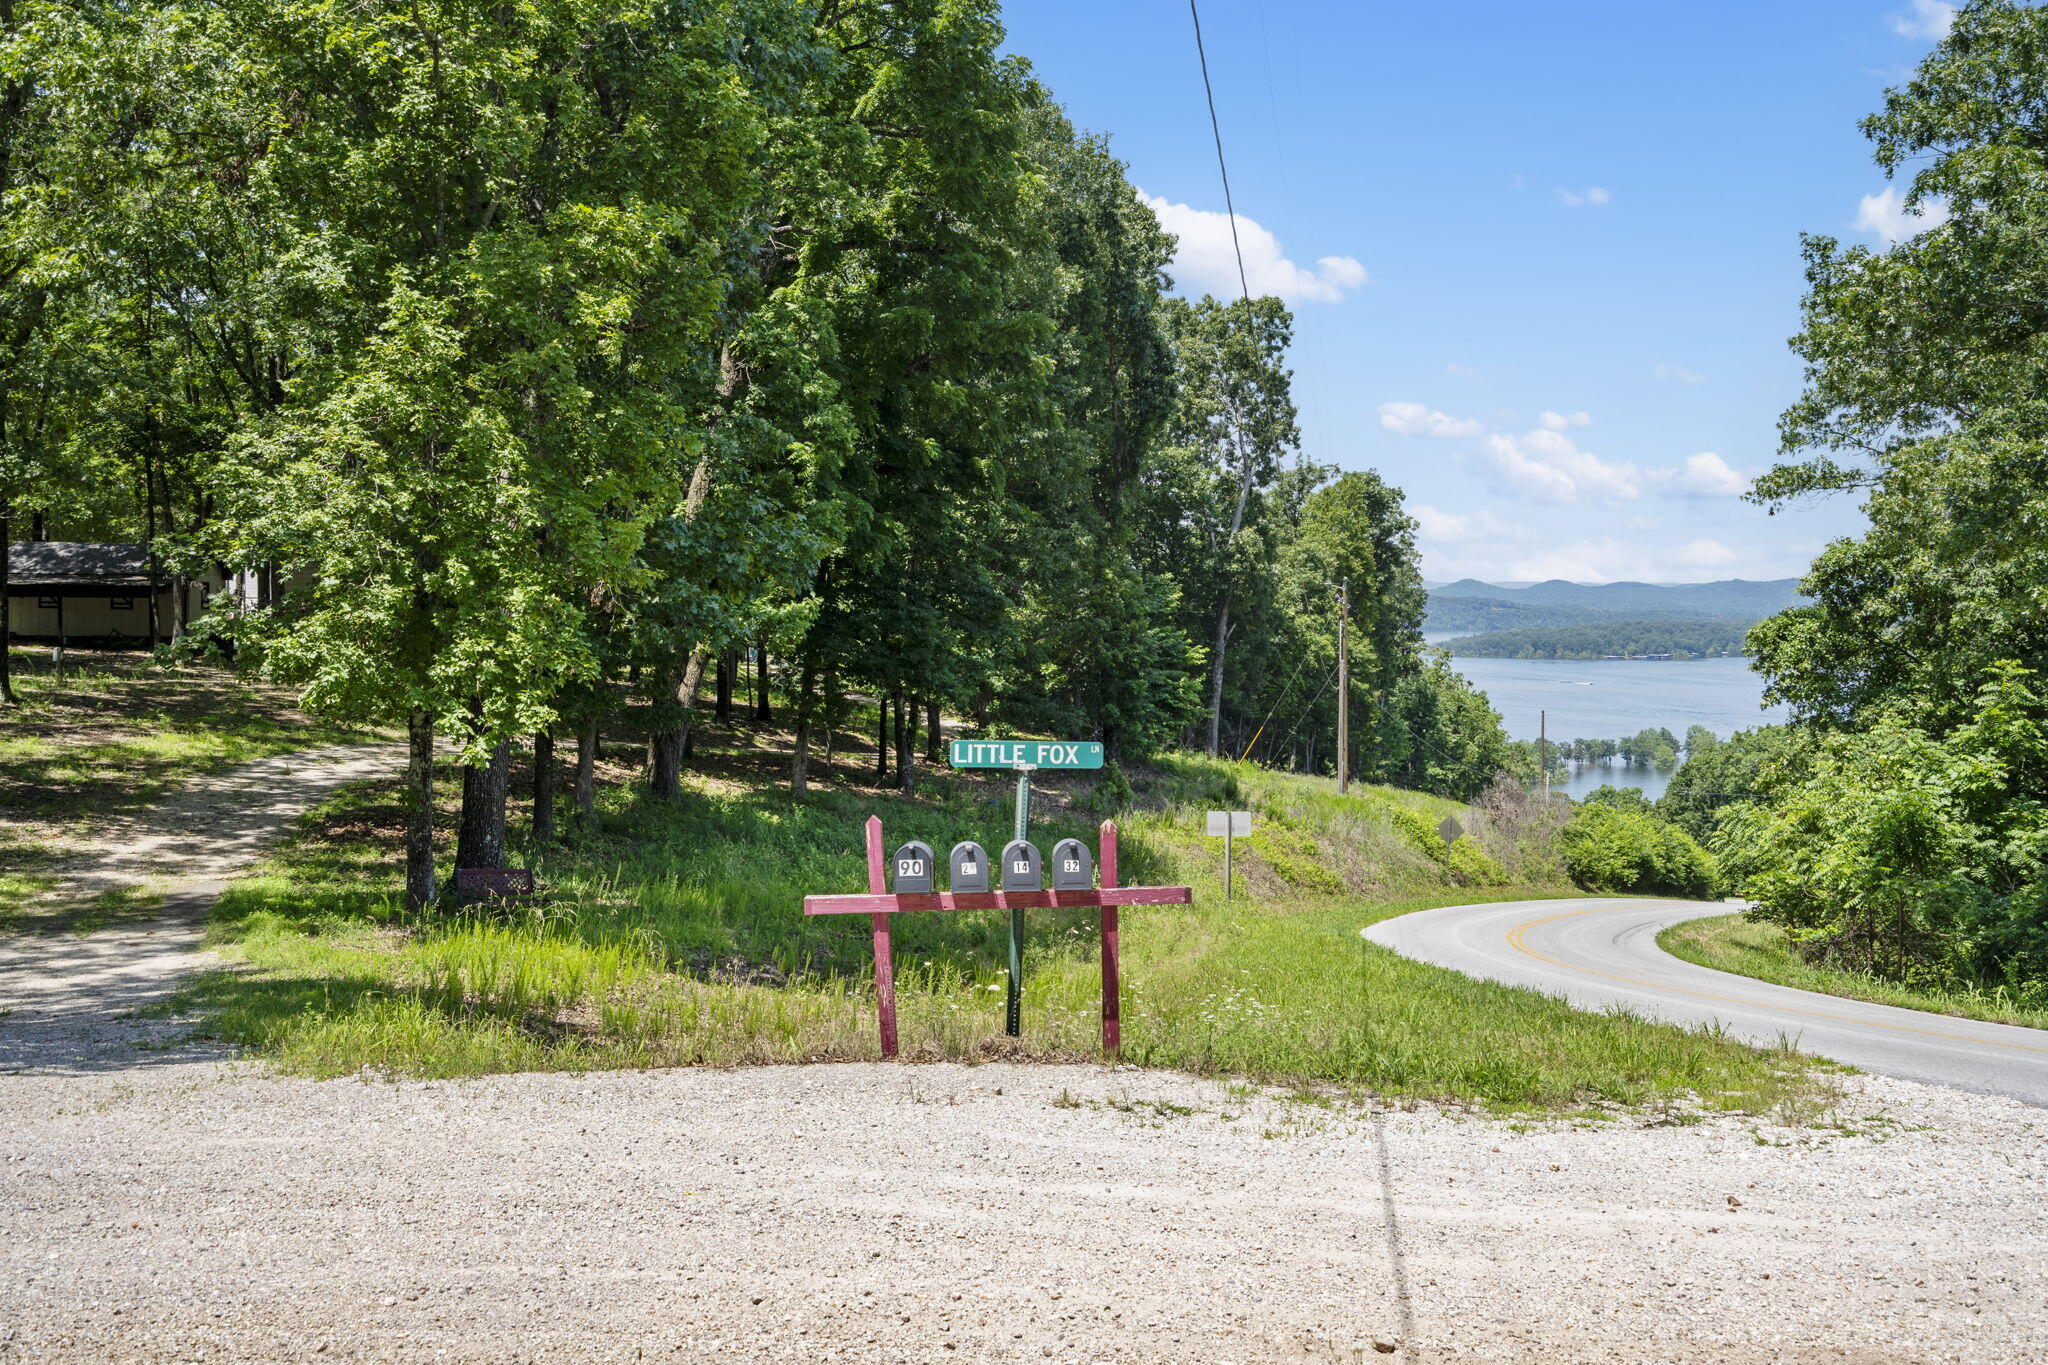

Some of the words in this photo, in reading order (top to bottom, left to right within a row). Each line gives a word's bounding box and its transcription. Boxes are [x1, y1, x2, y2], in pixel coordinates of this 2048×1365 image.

[955, 744, 1026, 764] LITTLE
[1037, 745, 1079, 765] FOX
[901, 861, 922, 875] 90
[1016, 862, 1027, 872] 14
[1066, 861, 1078, 871] 32
